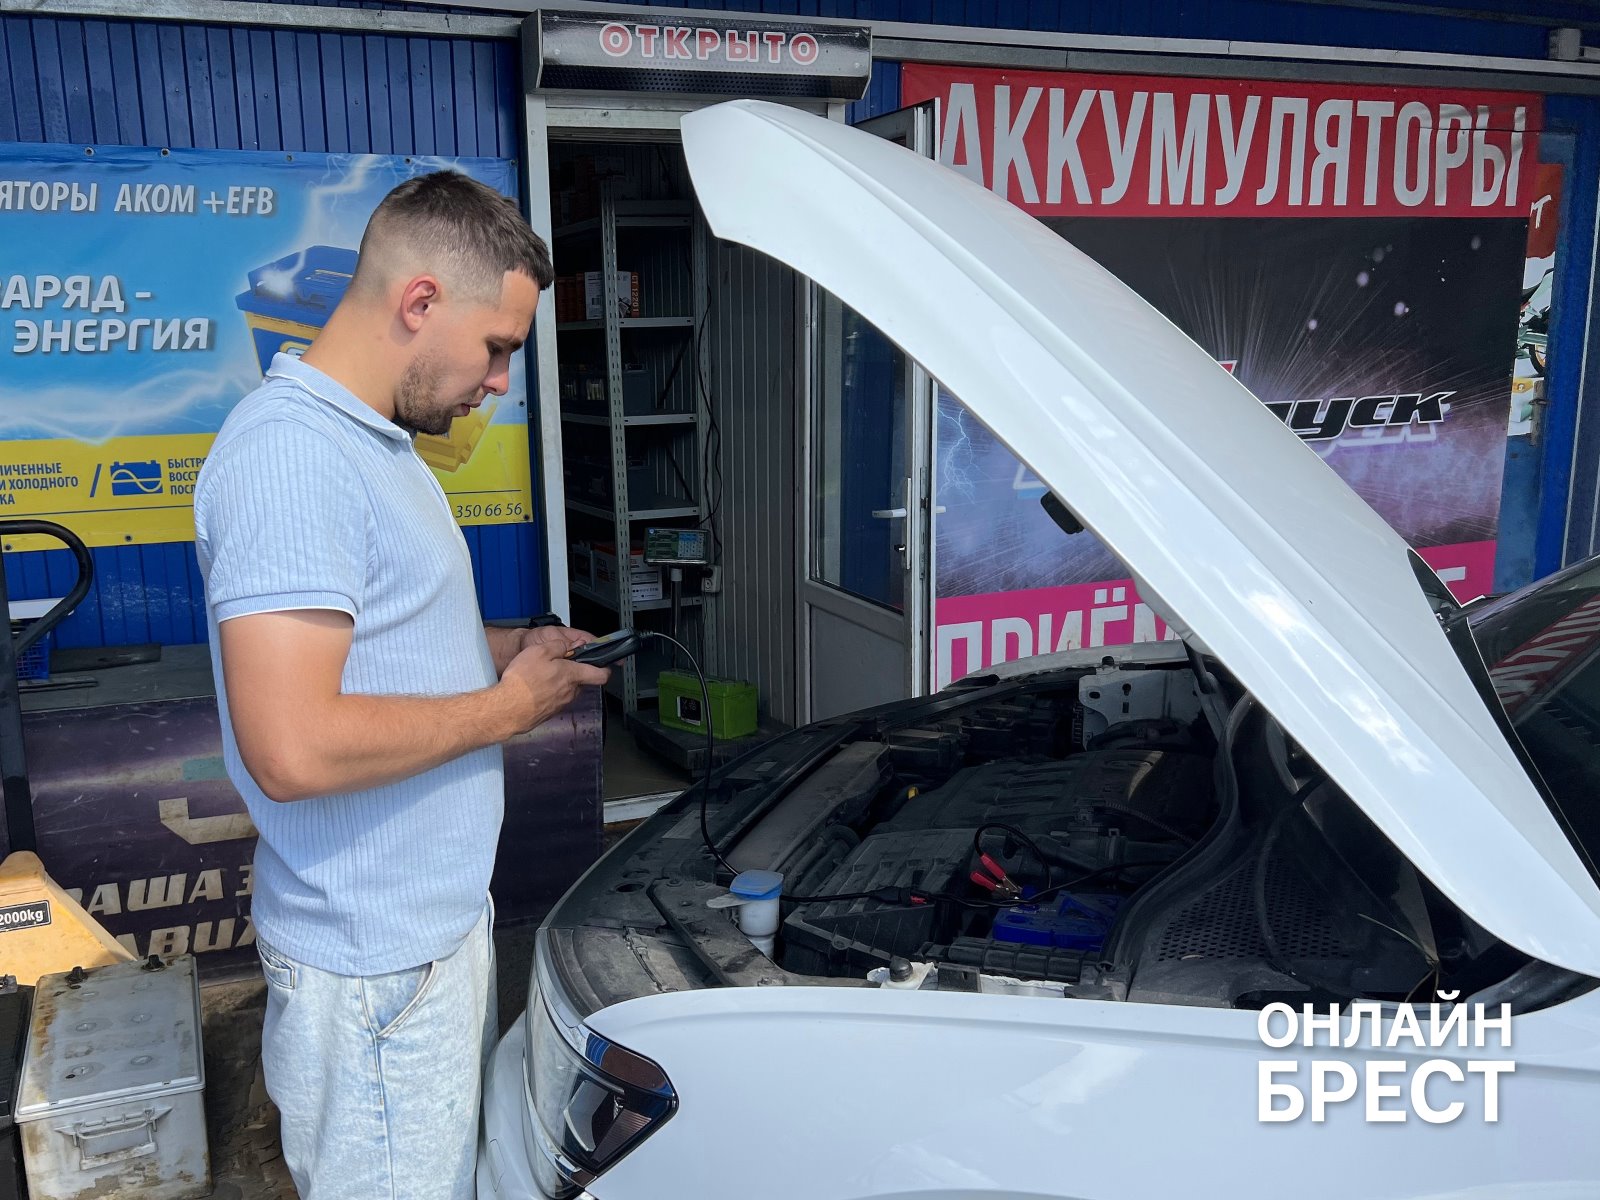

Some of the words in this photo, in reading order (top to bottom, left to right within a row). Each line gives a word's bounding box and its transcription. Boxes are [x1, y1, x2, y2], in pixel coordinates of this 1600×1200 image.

[600, 22, 819, 65] ОТКРЫТО
[939, 82, 1526, 207] АККУМУЛЯТОРЫ
[0, 180, 97, 212] ЯТОРЫ
[114, 183, 195, 213] АКОМ
[203, 186, 274, 215] +EFB
[0, 275, 125, 313] АРЯД
[13, 318, 209, 352] ЭНЕРГИЯ
[9, 476, 78, 490] ХОЛОДНОГО
[455, 505, 482, 518] 350
[485, 503, 502, 516] 66
[506, 502, 523, 515] 56
[0, 909, 44, 925] 2000kg
